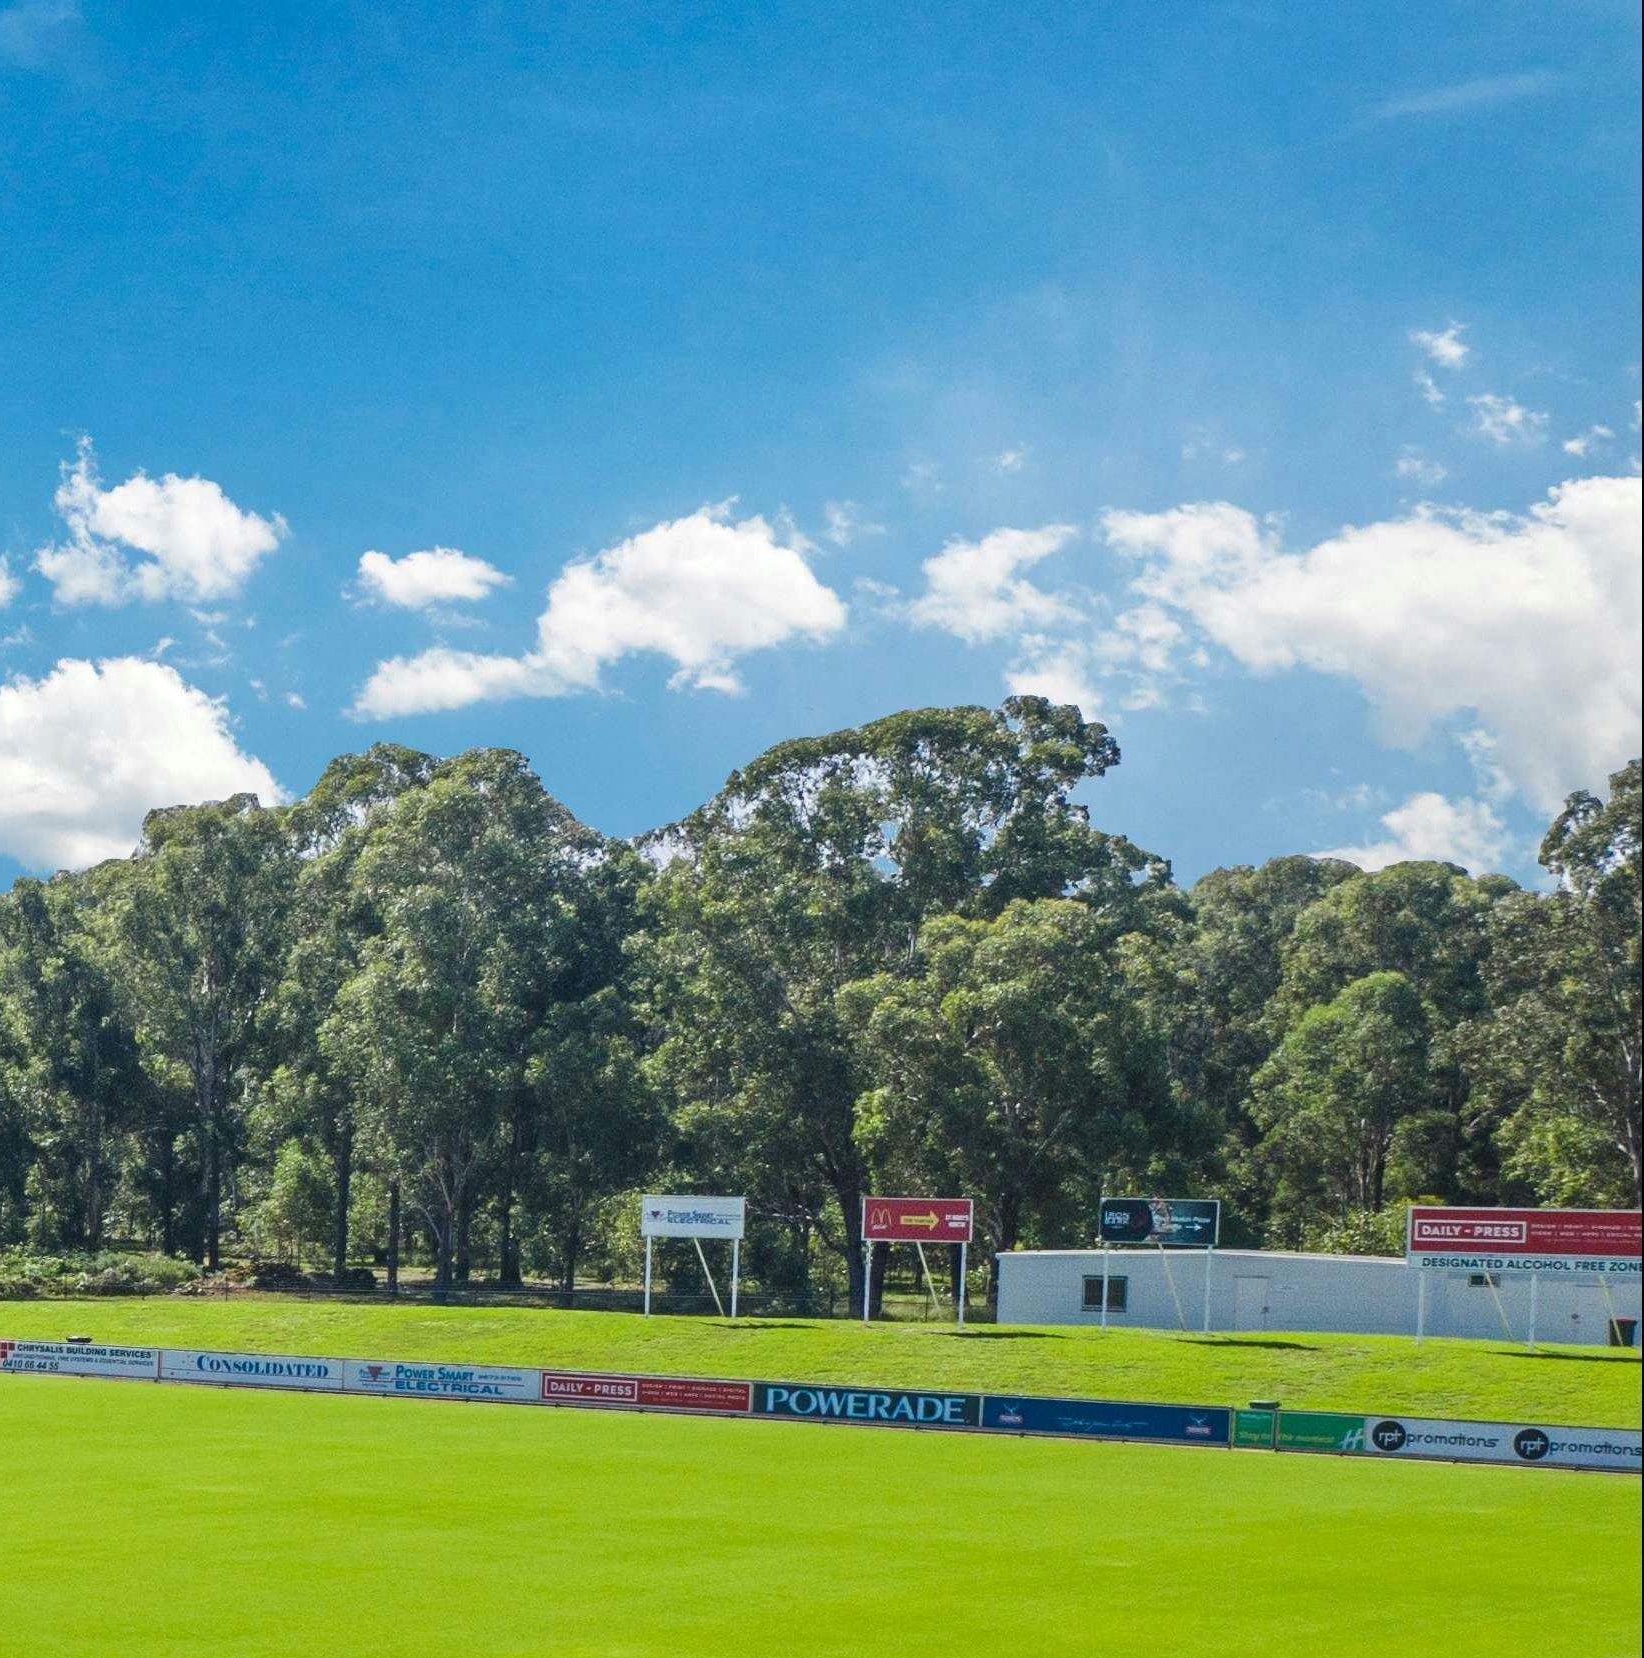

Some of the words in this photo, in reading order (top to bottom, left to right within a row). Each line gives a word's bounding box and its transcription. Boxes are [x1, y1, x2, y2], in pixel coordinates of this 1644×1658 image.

[1421, 1225, 1461, 1237] DAILY
[1473, 1226, 1519, 1238] PRESS
[1422, 1257, 1504, 1269] DESIGNATED
[1507, 1259, 1571, 1270] ALCOHOL
[1574, 1260, 1605, 1271] FREE
[17, 1343, 64, 1354] CHRYSALIS
[66, 1346, 107, 1356] BUILDING
[109, 1348, 152, 1359] SERVICES
[196, 1354, 329, 1378] CONSOLIDATED
[395, 1365, 435, 1381] POWER
[437, 1366, 475, 1382] SMART
[395, 1380, 504, 1395] ELECTRICAL
[550, 1381, 583, 1394] DAILY
[594, 1384, 632, 1396] PRESS
[766, 1387, 966, 1423] POWERADE
[1405, 1432, 1499, 1448] promotions
[1548, 1440, 1643, 1457] promotions
